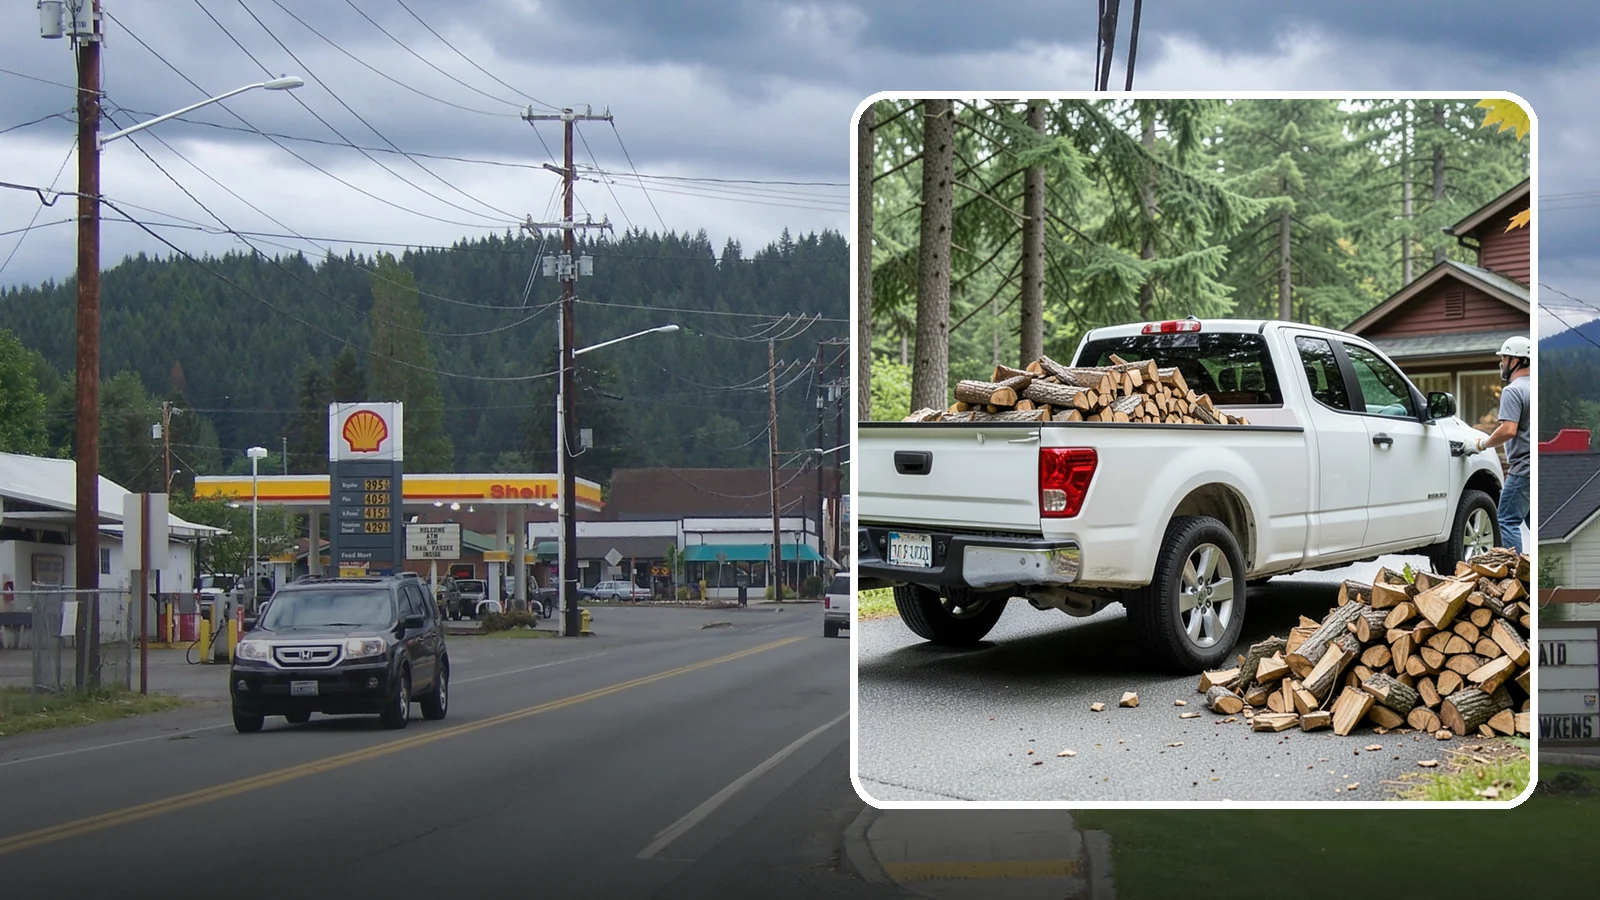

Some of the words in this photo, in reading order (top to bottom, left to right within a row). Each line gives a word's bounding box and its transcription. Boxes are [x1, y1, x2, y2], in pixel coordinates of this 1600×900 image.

[366, 480, 383, 490] 395
[490, 484, 547, 498] Shell
[366, 494, 383, 504] 405
[366, 508, 383, 518] 415
[366, 522, 383, 532] 429
[1538, 642, 1567, 666] AID
